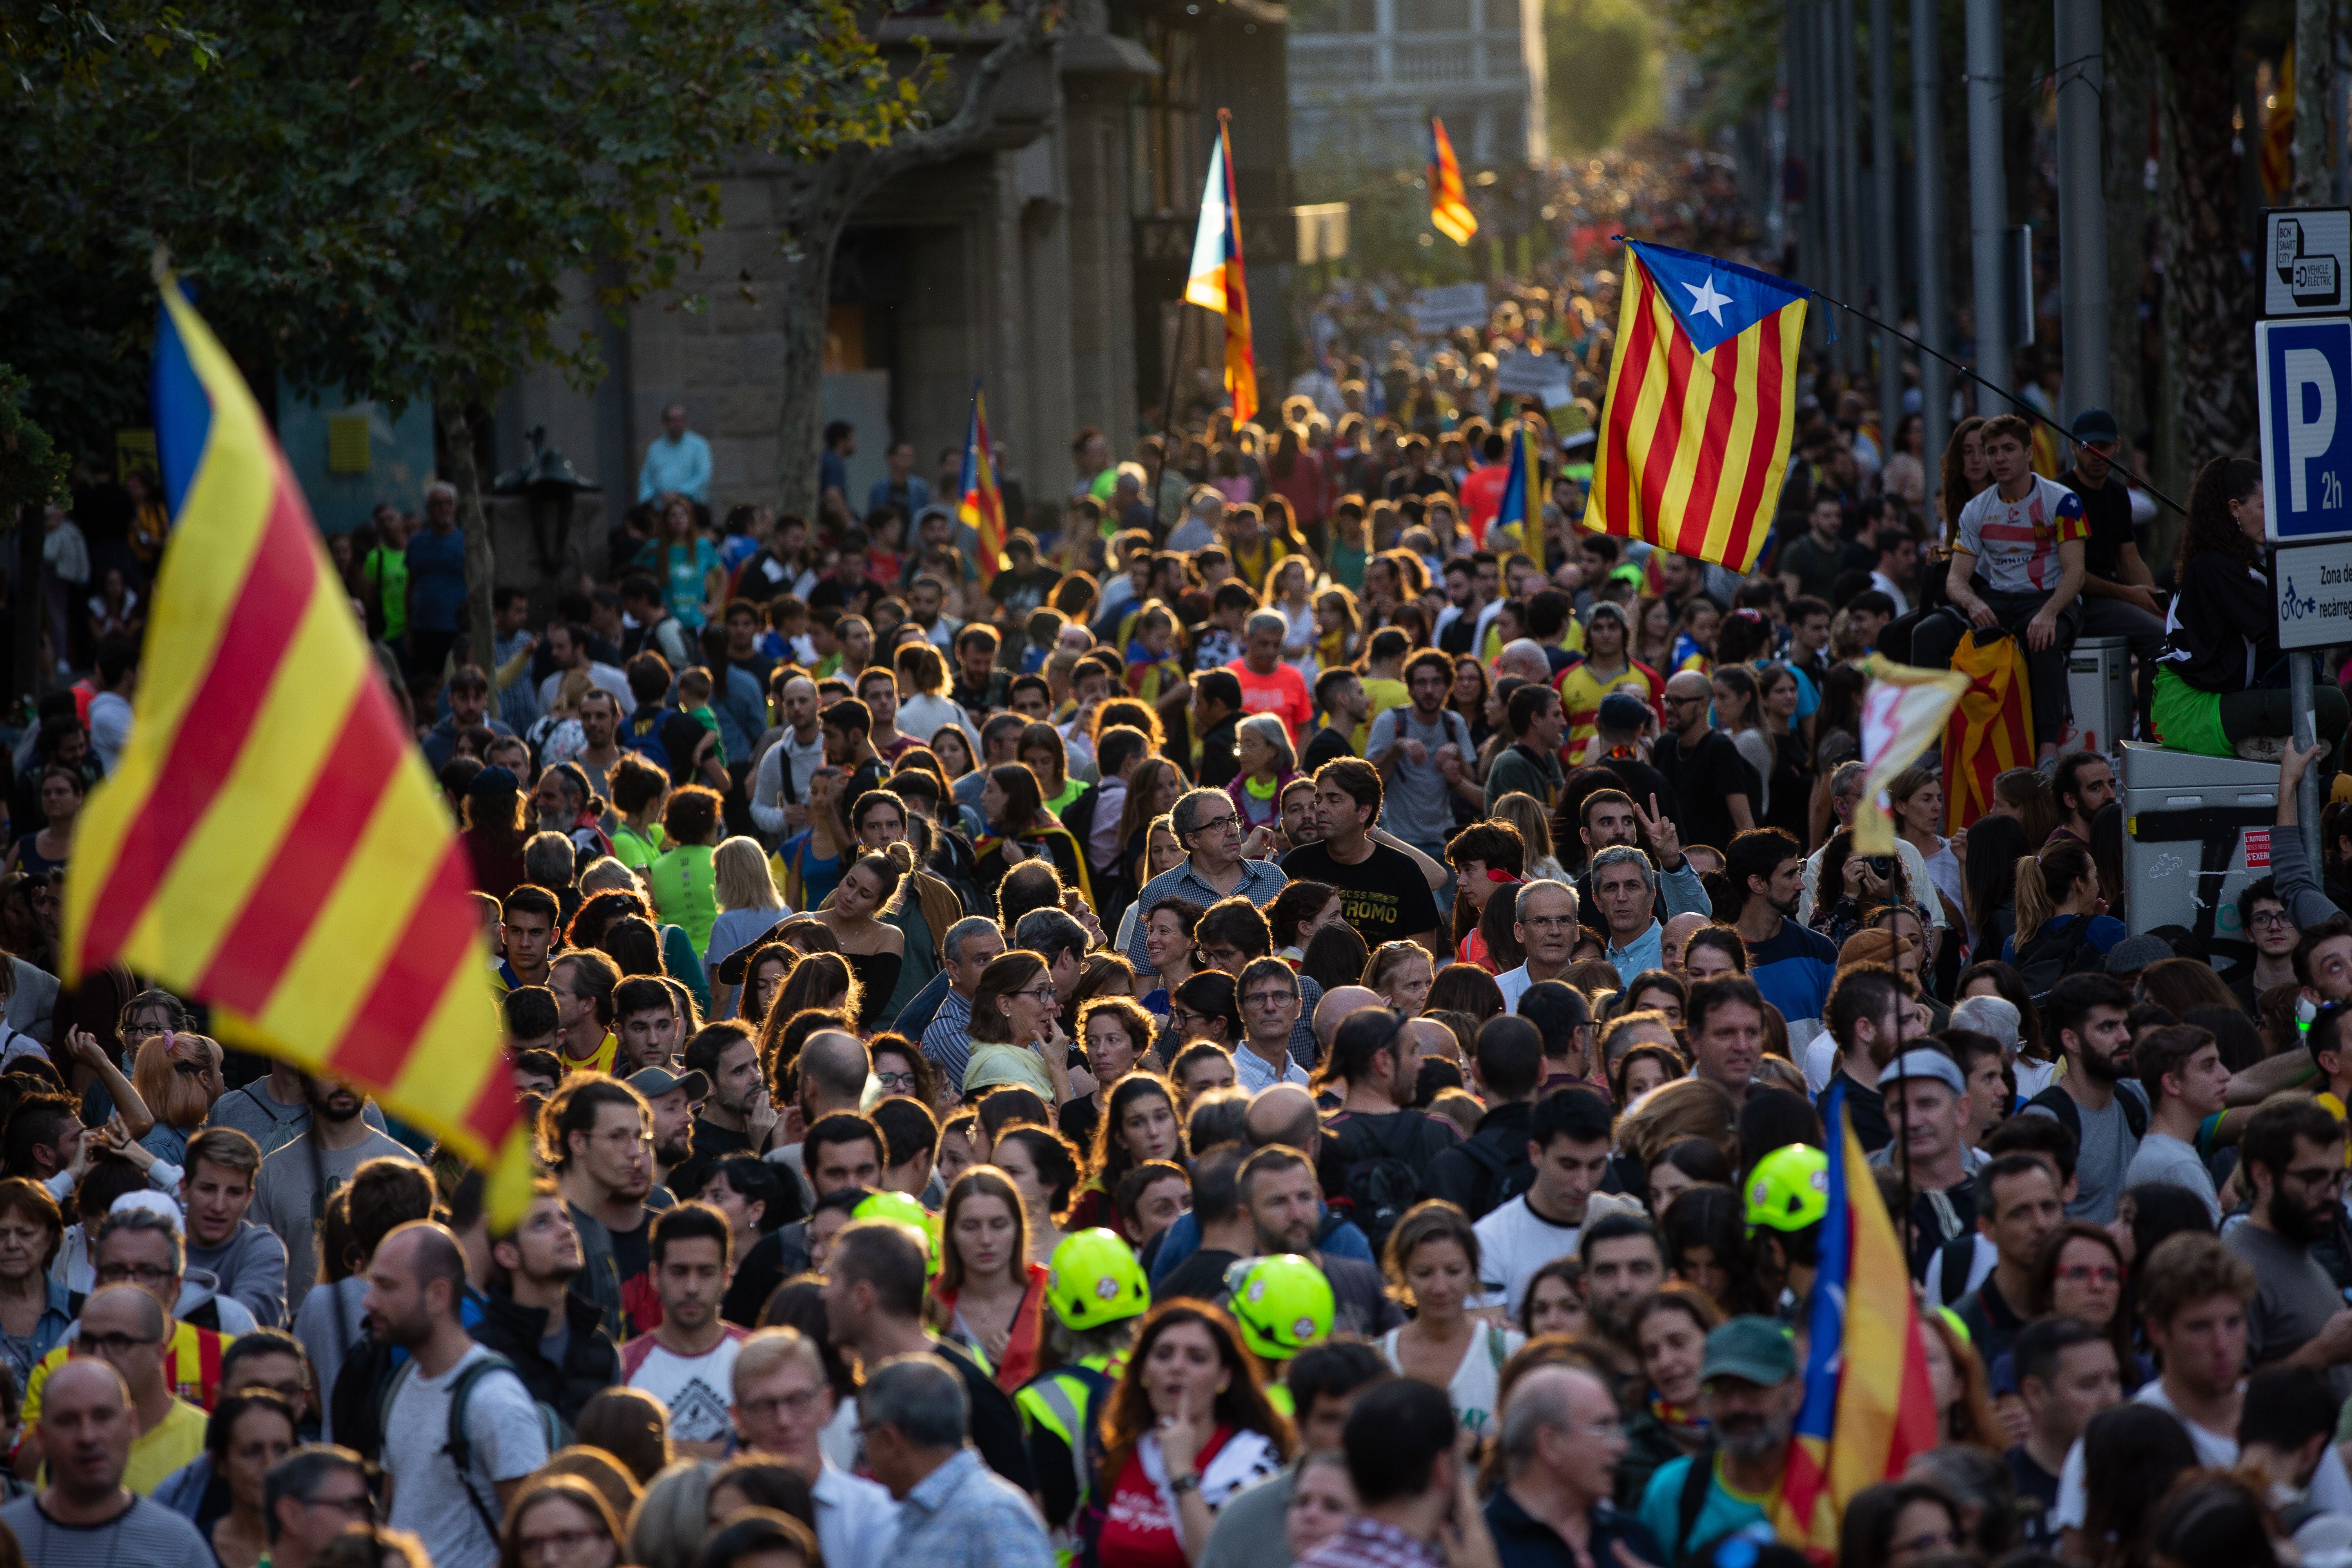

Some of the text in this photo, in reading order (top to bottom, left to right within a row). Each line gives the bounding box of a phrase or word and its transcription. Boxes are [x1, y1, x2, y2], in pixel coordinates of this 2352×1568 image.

[2279, 228, 2291, 238] BCN
[2279, 240, 2296, 250] SMART
[2279, 253, 2290, 263] CITY
[2307, 265, 2328, 274] VEHICLE
[2284, 349, 2336, 512] P
[2321, 470, 2342, 509] 2h
[2321, 563, 2352, 585] Zona de
